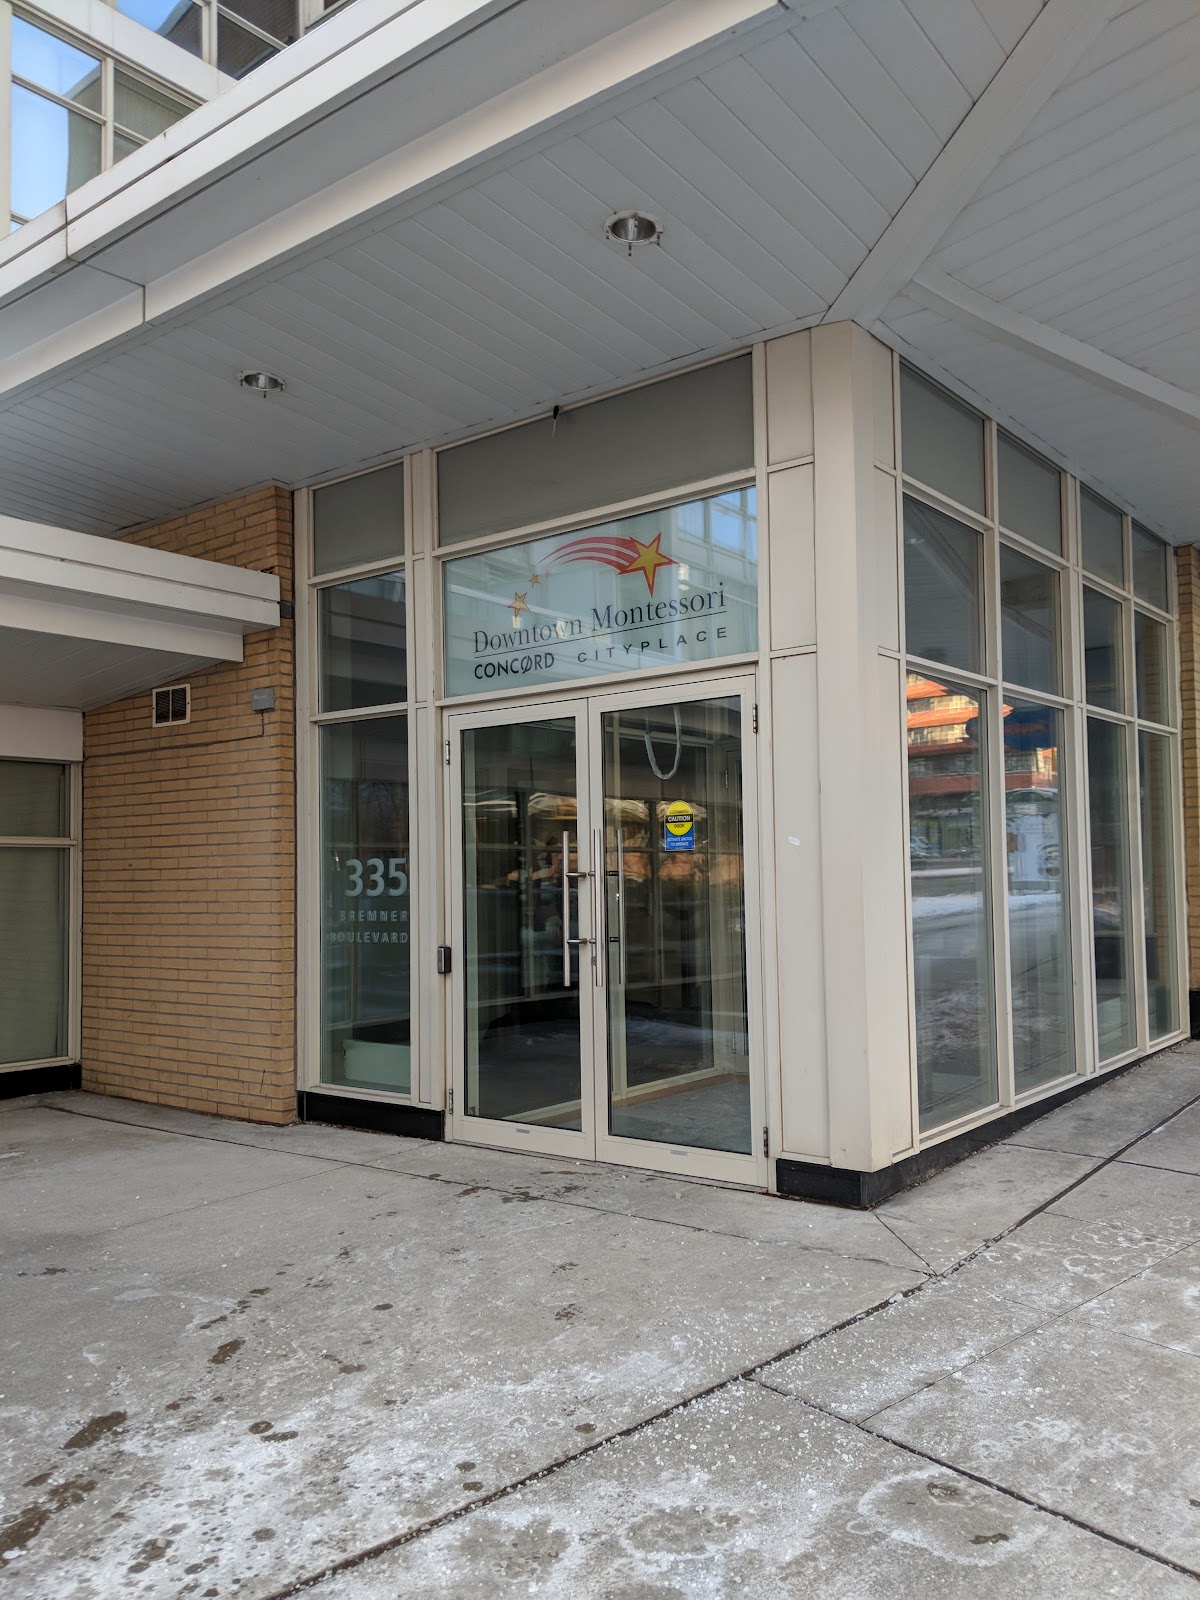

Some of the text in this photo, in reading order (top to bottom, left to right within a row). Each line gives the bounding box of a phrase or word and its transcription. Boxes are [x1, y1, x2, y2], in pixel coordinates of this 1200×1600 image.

[473, 581, 726, 653] Downtown Montessori
[577, 626, 727, 663] CITYPLACE
[668, 815, 691, 823] CAUTION
[344, 857, 408, 897] 335
[338, 910, 408, 922] BREMNER
[329, 932, 408, 943] BOULEVARD
